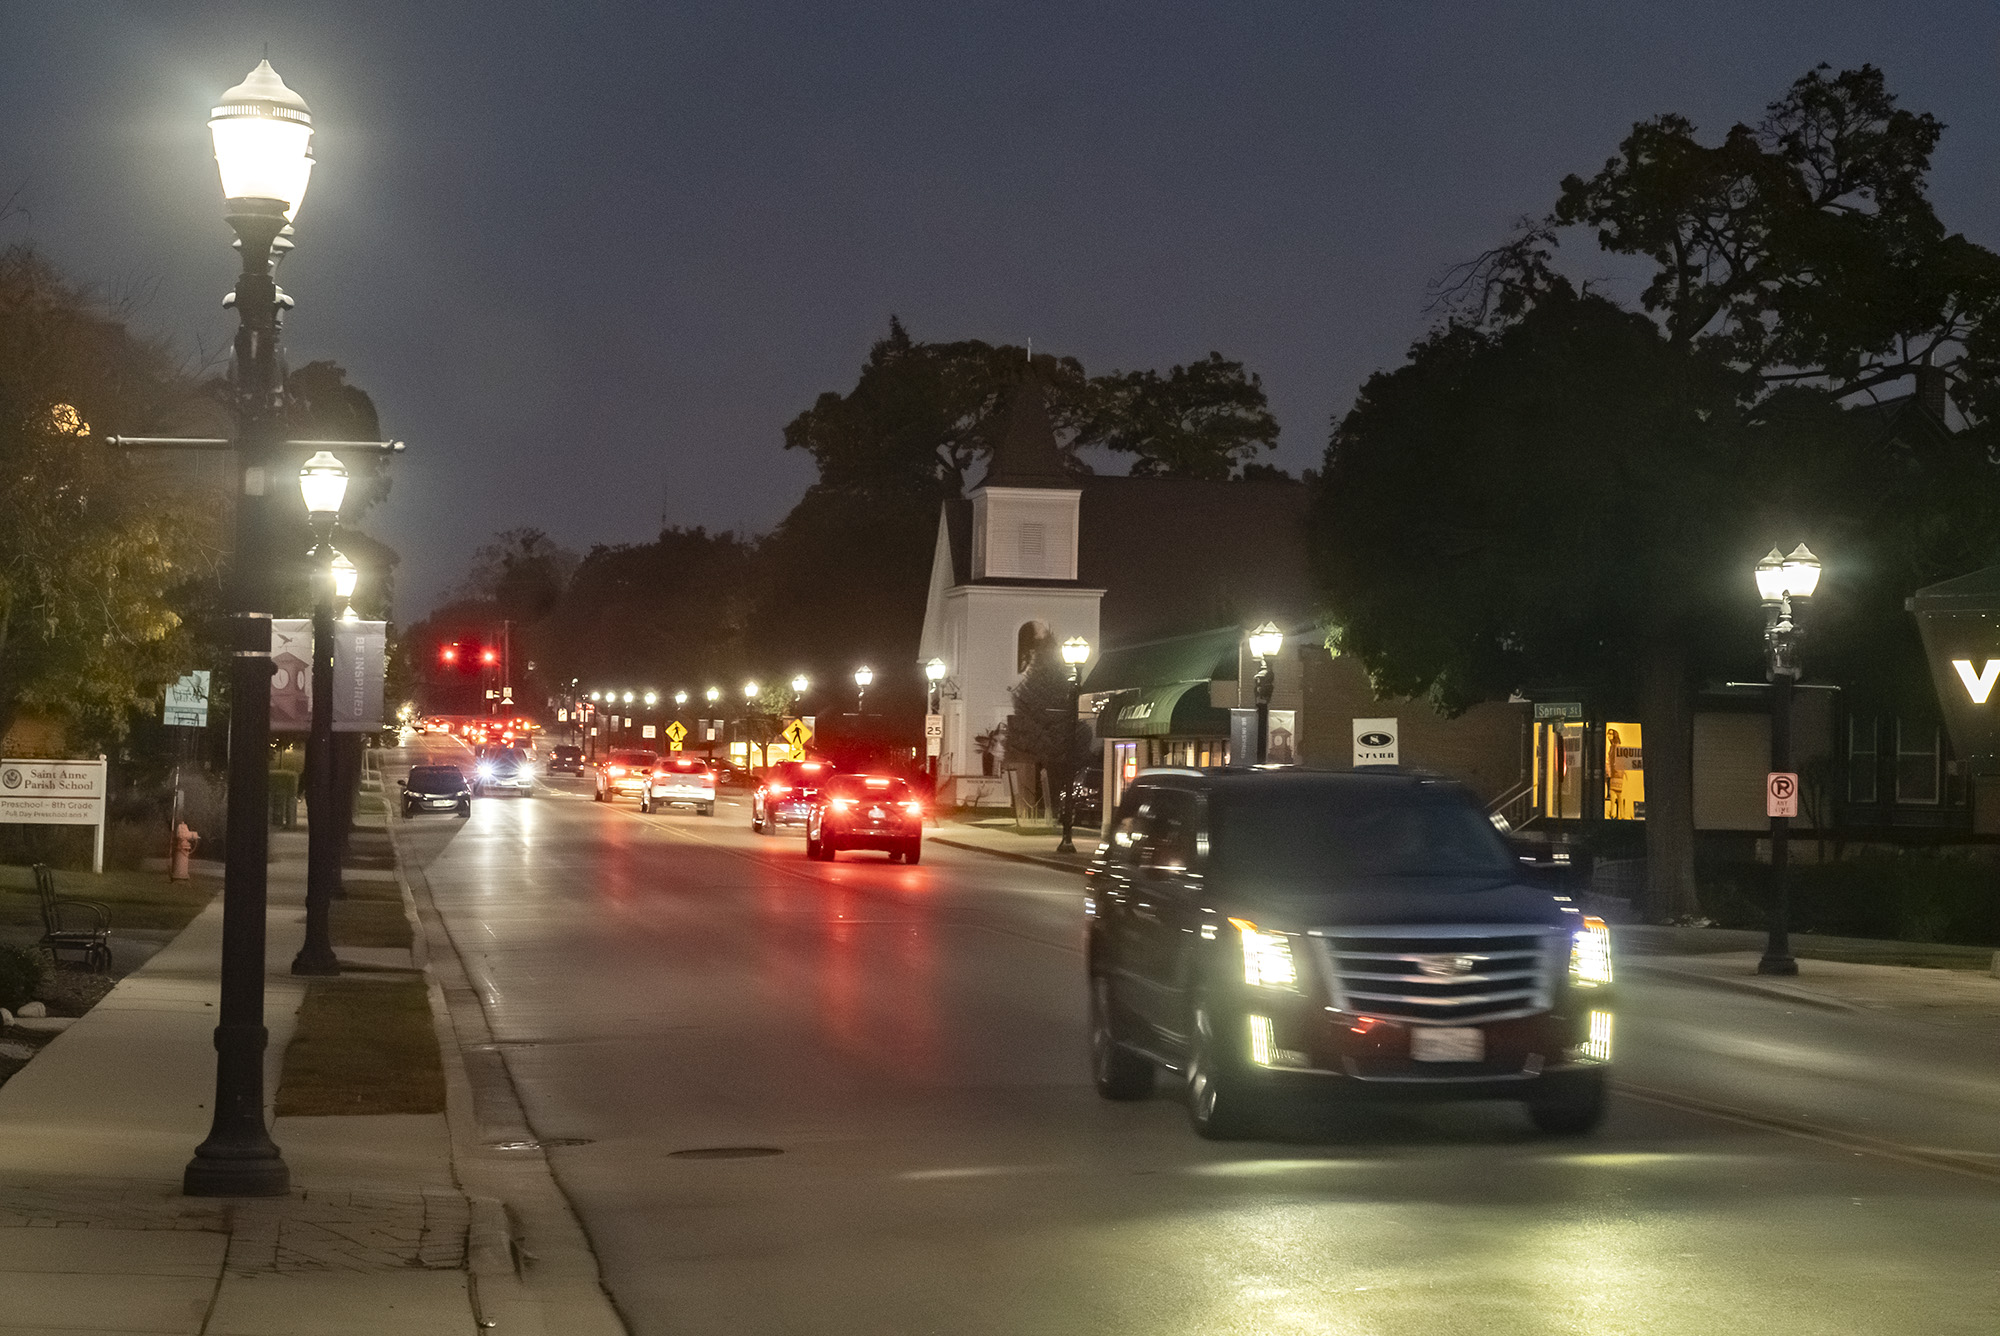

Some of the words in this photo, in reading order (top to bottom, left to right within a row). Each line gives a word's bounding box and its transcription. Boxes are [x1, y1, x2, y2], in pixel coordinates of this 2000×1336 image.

[355, 636, 365, 654] BE
[353, 656, 365, 717] INSPIRED
[1951, 659, 2000, 704] V
[1538, 705, 1567, 717] Spring
[927, 726, 942, 736] 25
[30, 769, 56, 779] Saint
[59, 770, 88, 780] Anne
[24, 780, 56, 790] Parish
[58, 780, 94, 790] School
[1, 801, 43, 809] Preschool
[51, 801, 66, 809] 8th
[67, 802, 94, 810] Grade
